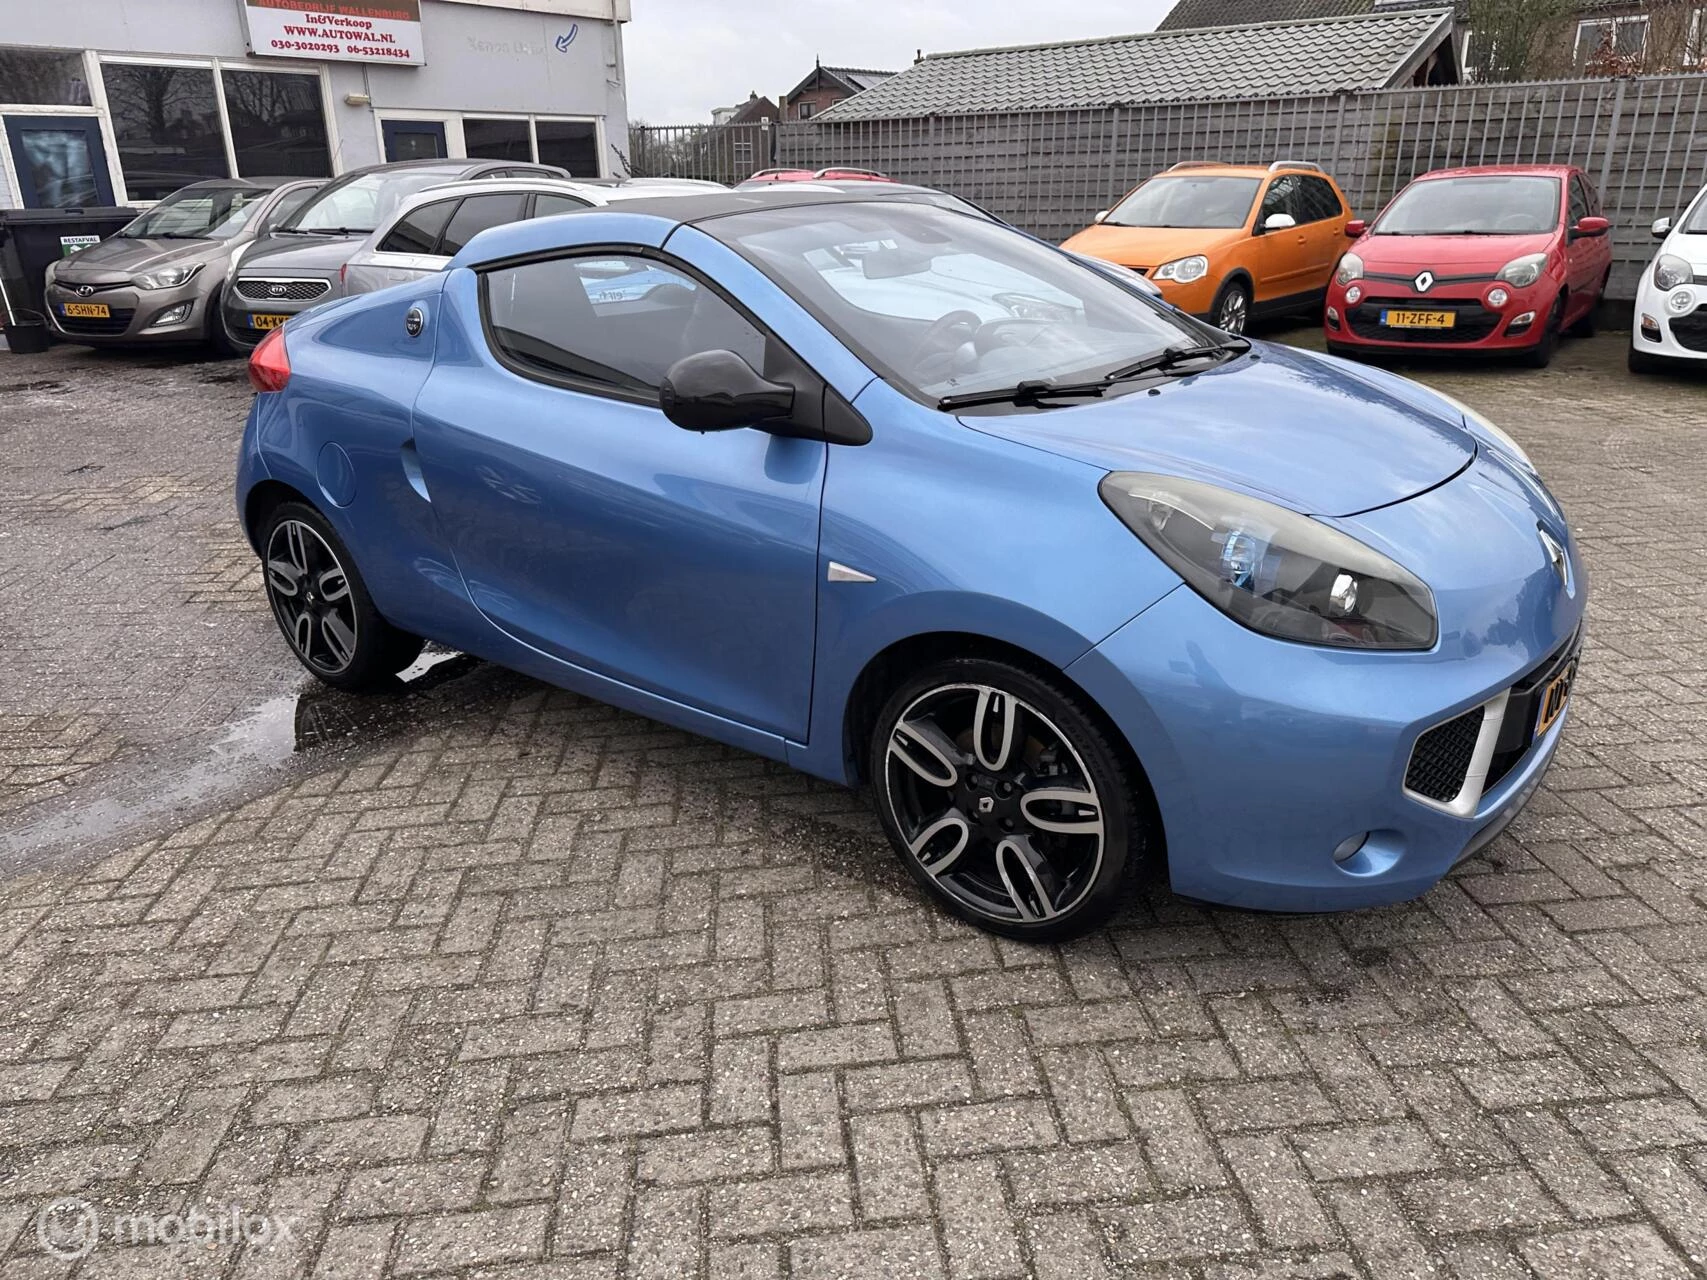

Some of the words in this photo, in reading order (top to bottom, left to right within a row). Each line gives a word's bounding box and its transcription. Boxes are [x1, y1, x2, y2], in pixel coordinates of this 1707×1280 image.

[260, 0, 335, 13] AUTOBEDRIJF
[339, 6, 410, 20] WALLENBURG
[305, 14, 372, 29] In&Verkoop
[283, 25, 395, 43] WWW.AUTOWAL.NL
[271, 39, 340, 53] 030-3020293
[347, 45, 410, 58] 06-53218434
[67, 304, 107, 316] 6-SHN-74
[1395, 312, 1446, 325] 11-ZFF-4
